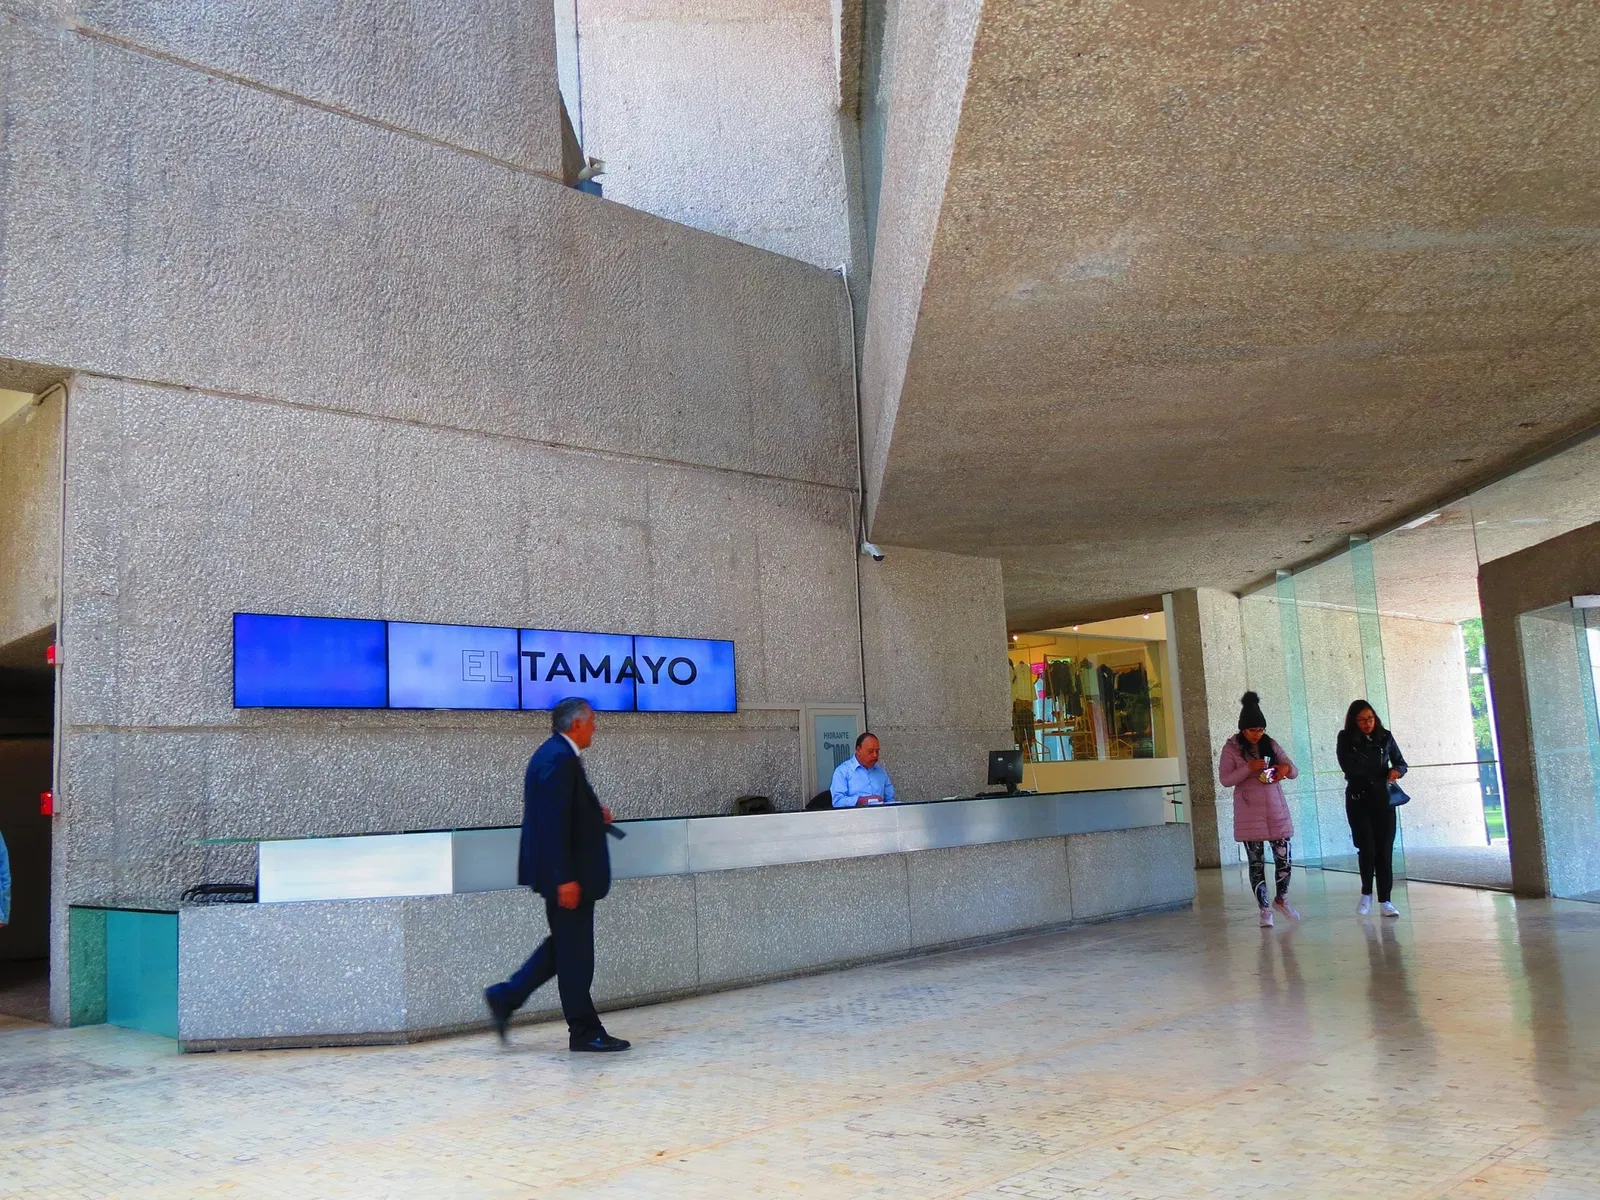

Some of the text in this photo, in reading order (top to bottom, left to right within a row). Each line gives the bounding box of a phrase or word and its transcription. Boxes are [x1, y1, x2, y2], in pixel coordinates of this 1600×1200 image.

[461, 650, 698, 686] EL TAMAYO
[823, 731, 850, 740] HIDRANTE
